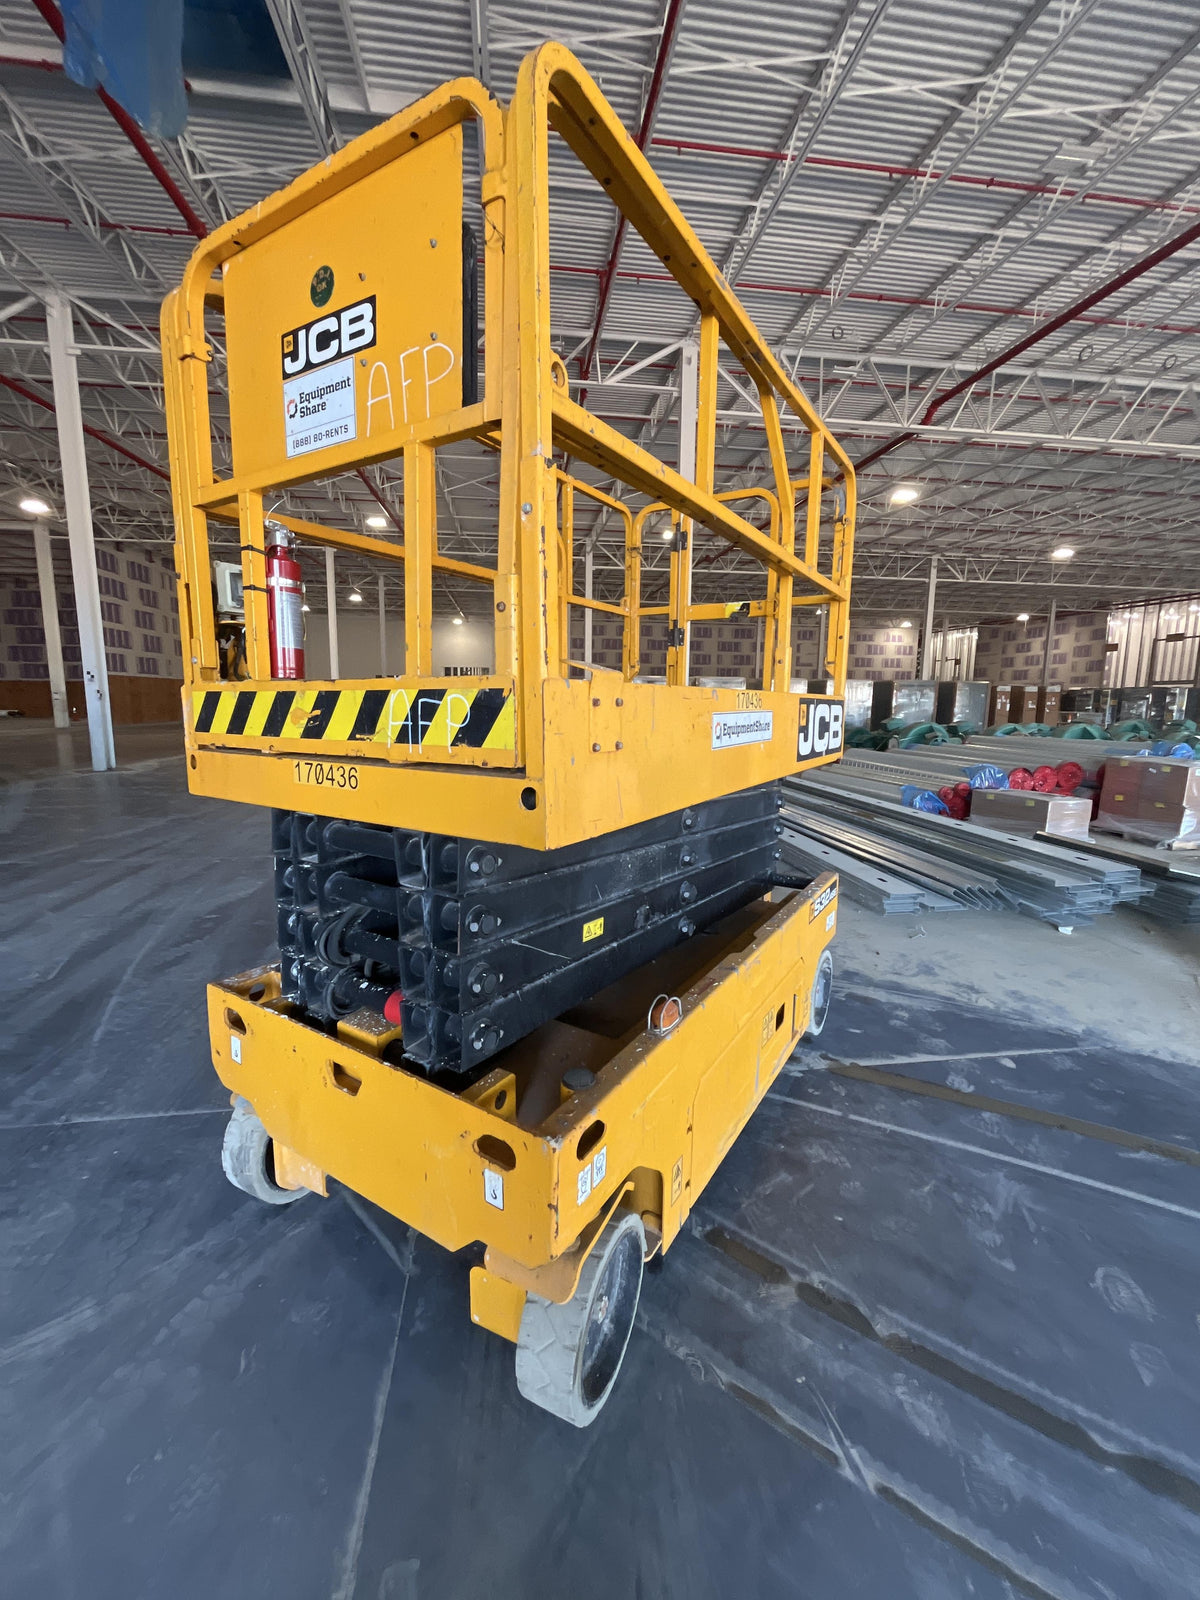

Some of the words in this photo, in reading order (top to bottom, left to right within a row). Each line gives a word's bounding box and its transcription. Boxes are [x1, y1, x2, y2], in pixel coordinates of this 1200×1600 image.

[284, 302, 374, 374] JCB
[299, 376, 351, 404] Equipment
[367, 343, 454, 438] AFP
[299, 401, 327, 418] Share
[293, 435, 311, 449] (888)
[313, 424, 349, 443] 80-RENTS
[736, 692, 762, 709] 170436
[387, 689, 470, 754] AFP
[722, 720, 770, 738] EquipmentShare
[798, 703, 843, 756] JCB
[295, 762, 359, 790] 170436
